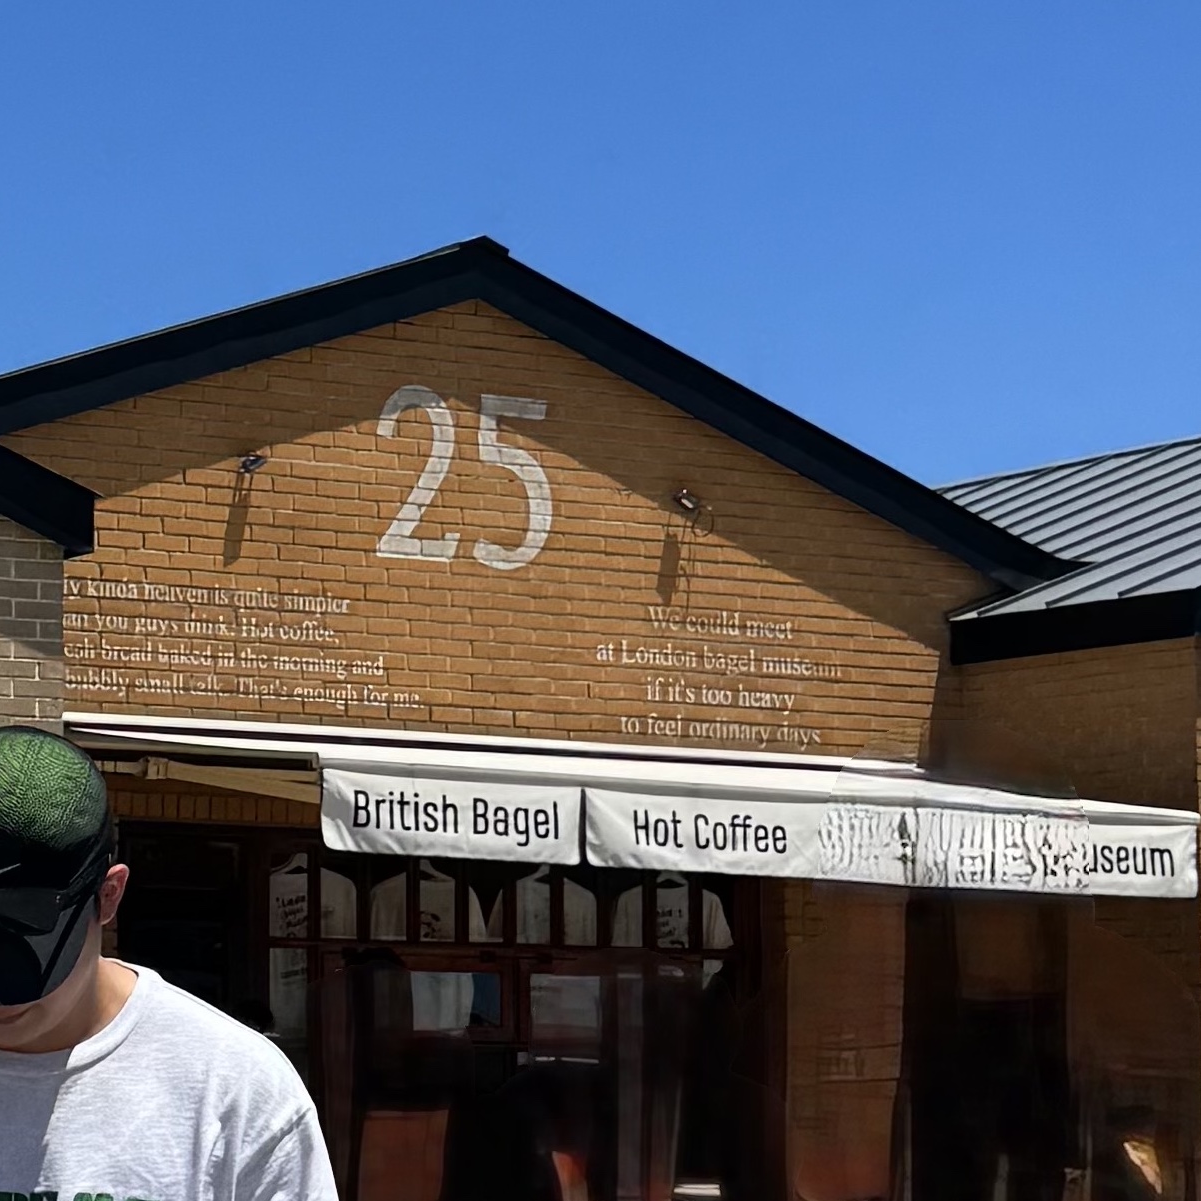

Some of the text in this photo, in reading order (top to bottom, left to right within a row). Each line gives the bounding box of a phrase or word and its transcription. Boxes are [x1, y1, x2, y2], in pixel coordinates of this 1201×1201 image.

[375, 385, 553, 570] 25
[215, 584, 229, 604] is
[95, 614, 128, 630] you
[135, 617, 178, 635] guys
[242, 617, 274, 638] Hot
[649, 606, 792, 639] We could meet
[101, 639, 152, 661] bread
[218, 645, 235, 667] in
[241, 648, 268, 669] the
[273, 652, 347, 679] morning
[352, 656, 384, 675] and
[596, 642, 614, 662] at
[622, 640, 696, 668] London
[704, 646, 755, 676] bagel
[294, 685, 356, 709] enough
[363, 685, 388, 706] for
[647, 677, 795, 714] if it's too heavy
[621, 716, 639, 734] to
[689, 718, 770, 748] ordinary
[777, 722, 821, 750] days
[352, 790, 559, 846] British Bagel
[634, 809, 684, 849] Hot
[695, 813, 787, 854] Coffee
